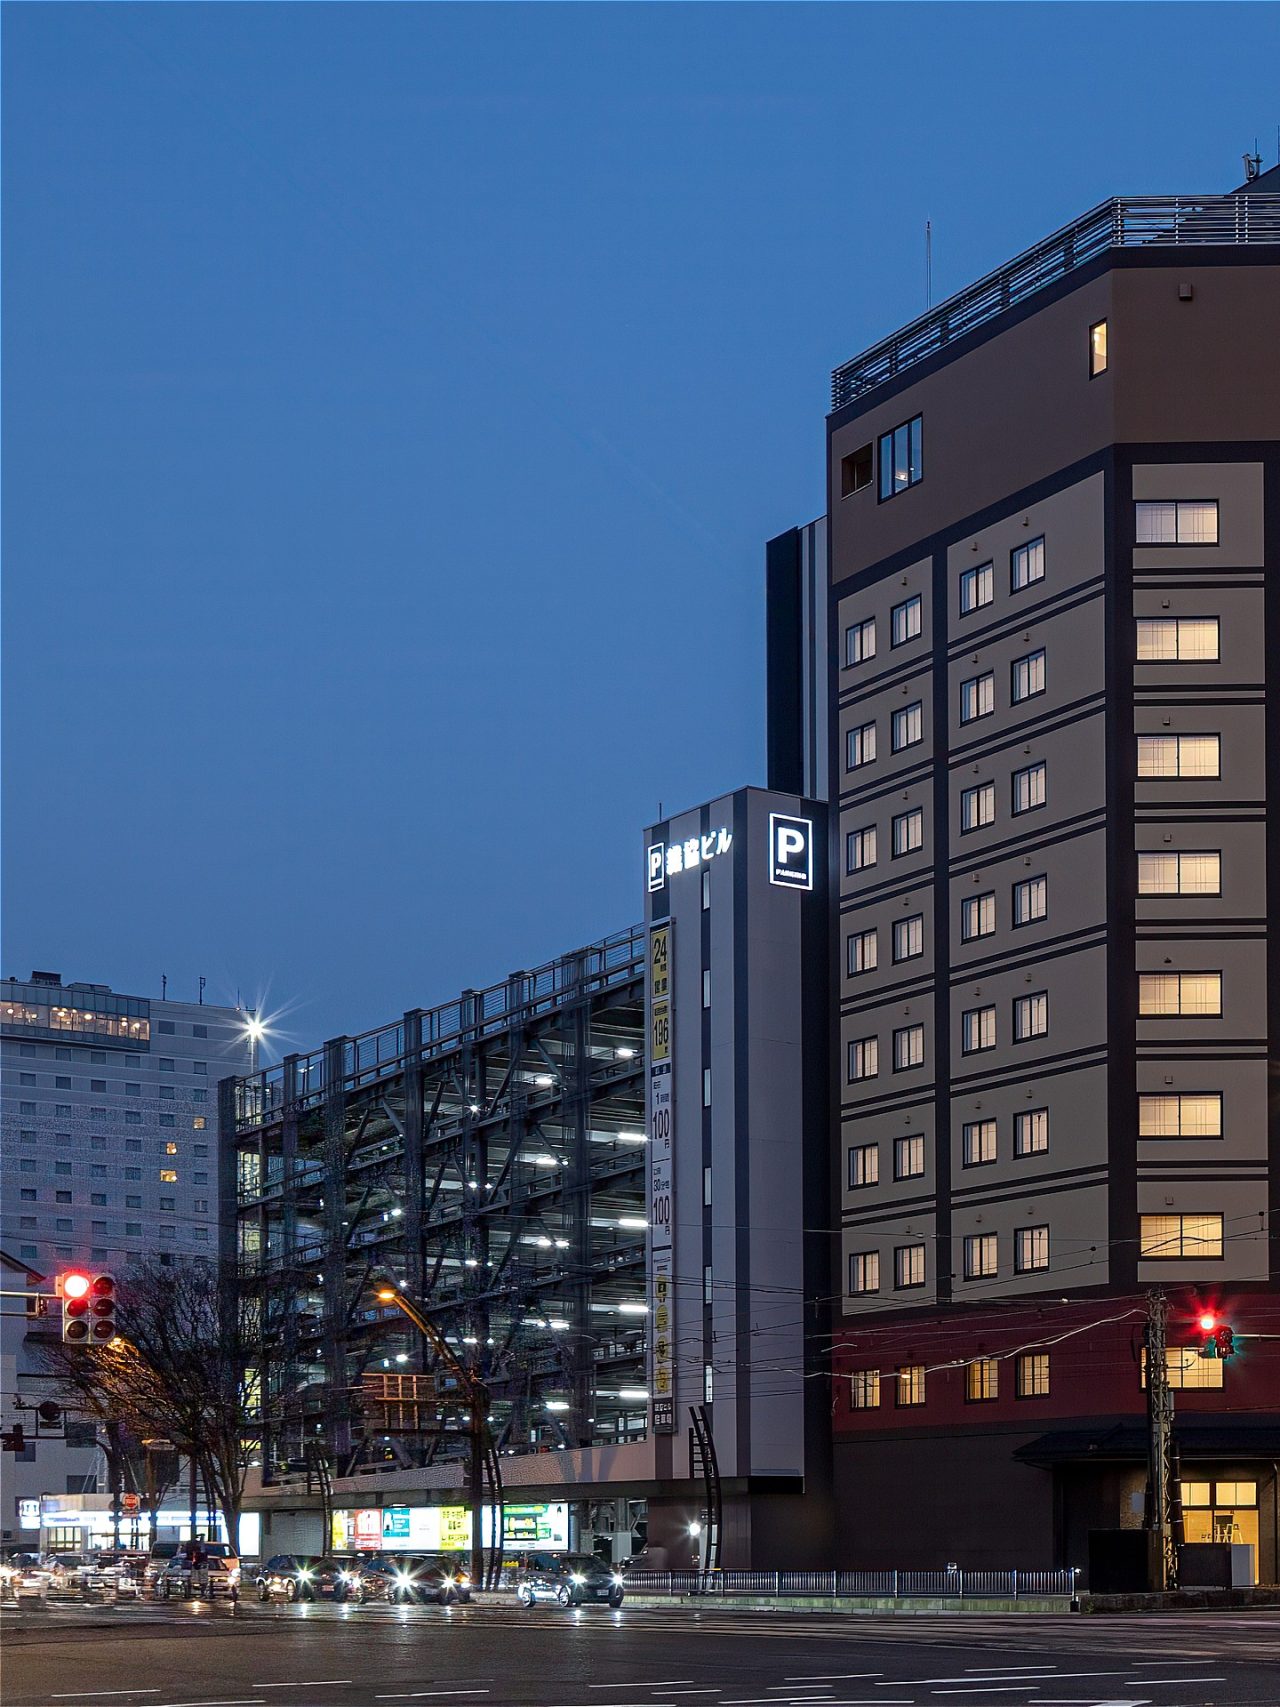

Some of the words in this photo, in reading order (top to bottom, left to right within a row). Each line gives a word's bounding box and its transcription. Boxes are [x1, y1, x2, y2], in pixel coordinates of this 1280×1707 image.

[776, 826, 805, 864] P
[651, 852, 662, 877] P
[653, 936, 668, 965] 24
[653, 1108, 670, 1140] 100
[653, 1195, 670, 1225] 100
